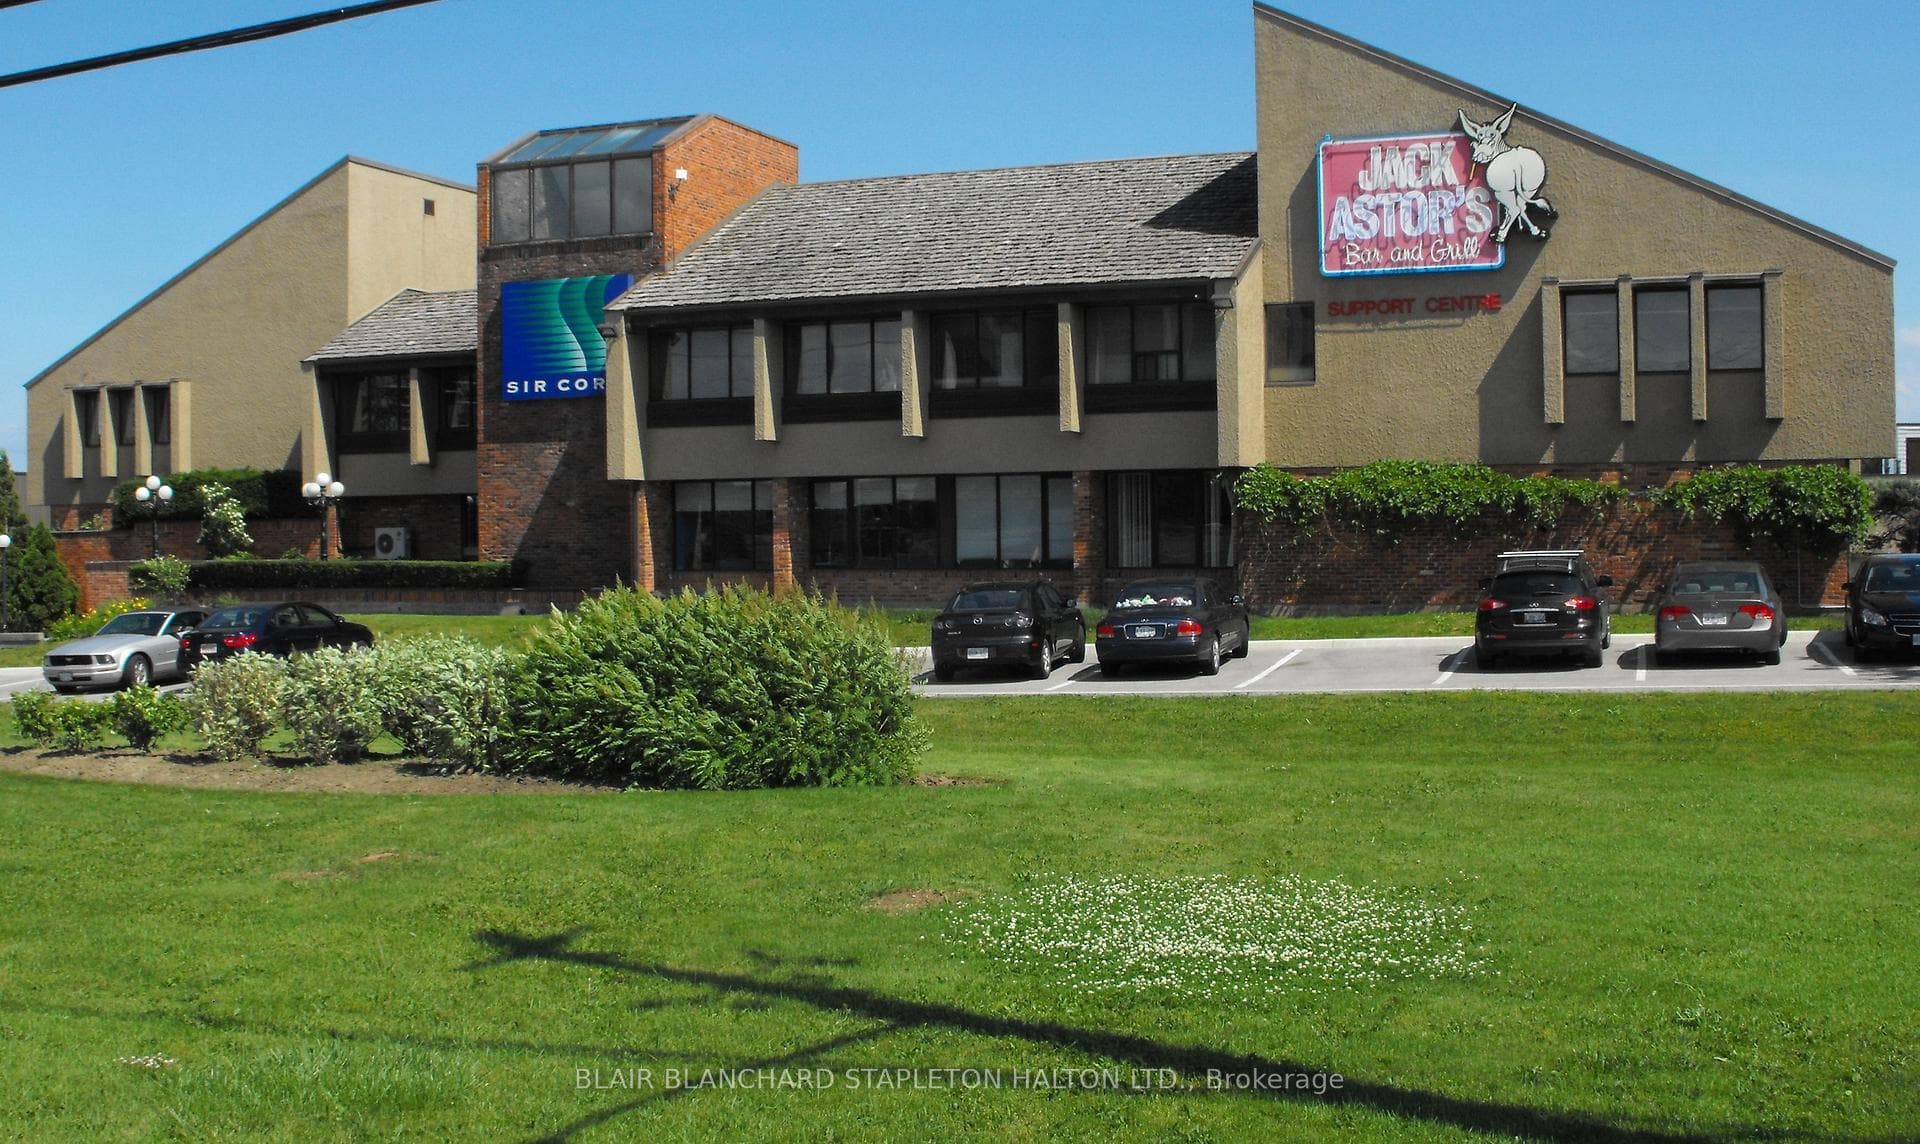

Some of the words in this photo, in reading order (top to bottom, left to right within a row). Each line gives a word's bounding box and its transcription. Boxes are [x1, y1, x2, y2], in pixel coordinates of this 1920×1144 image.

[1359, 141, 1459, 191] JACK
[1329, 186, 1493, 241] ASTOR'S
[1344, 243, 1383, 266] Bar
[1391, 241, 1424, 263] and
[1431, 236, 1481, 263] Grill
[1328, 298, 1416, 317] SUPPORT
[1425, 293, 1502, 314] CENTRE
[507, 380, 547, 394] SIR
